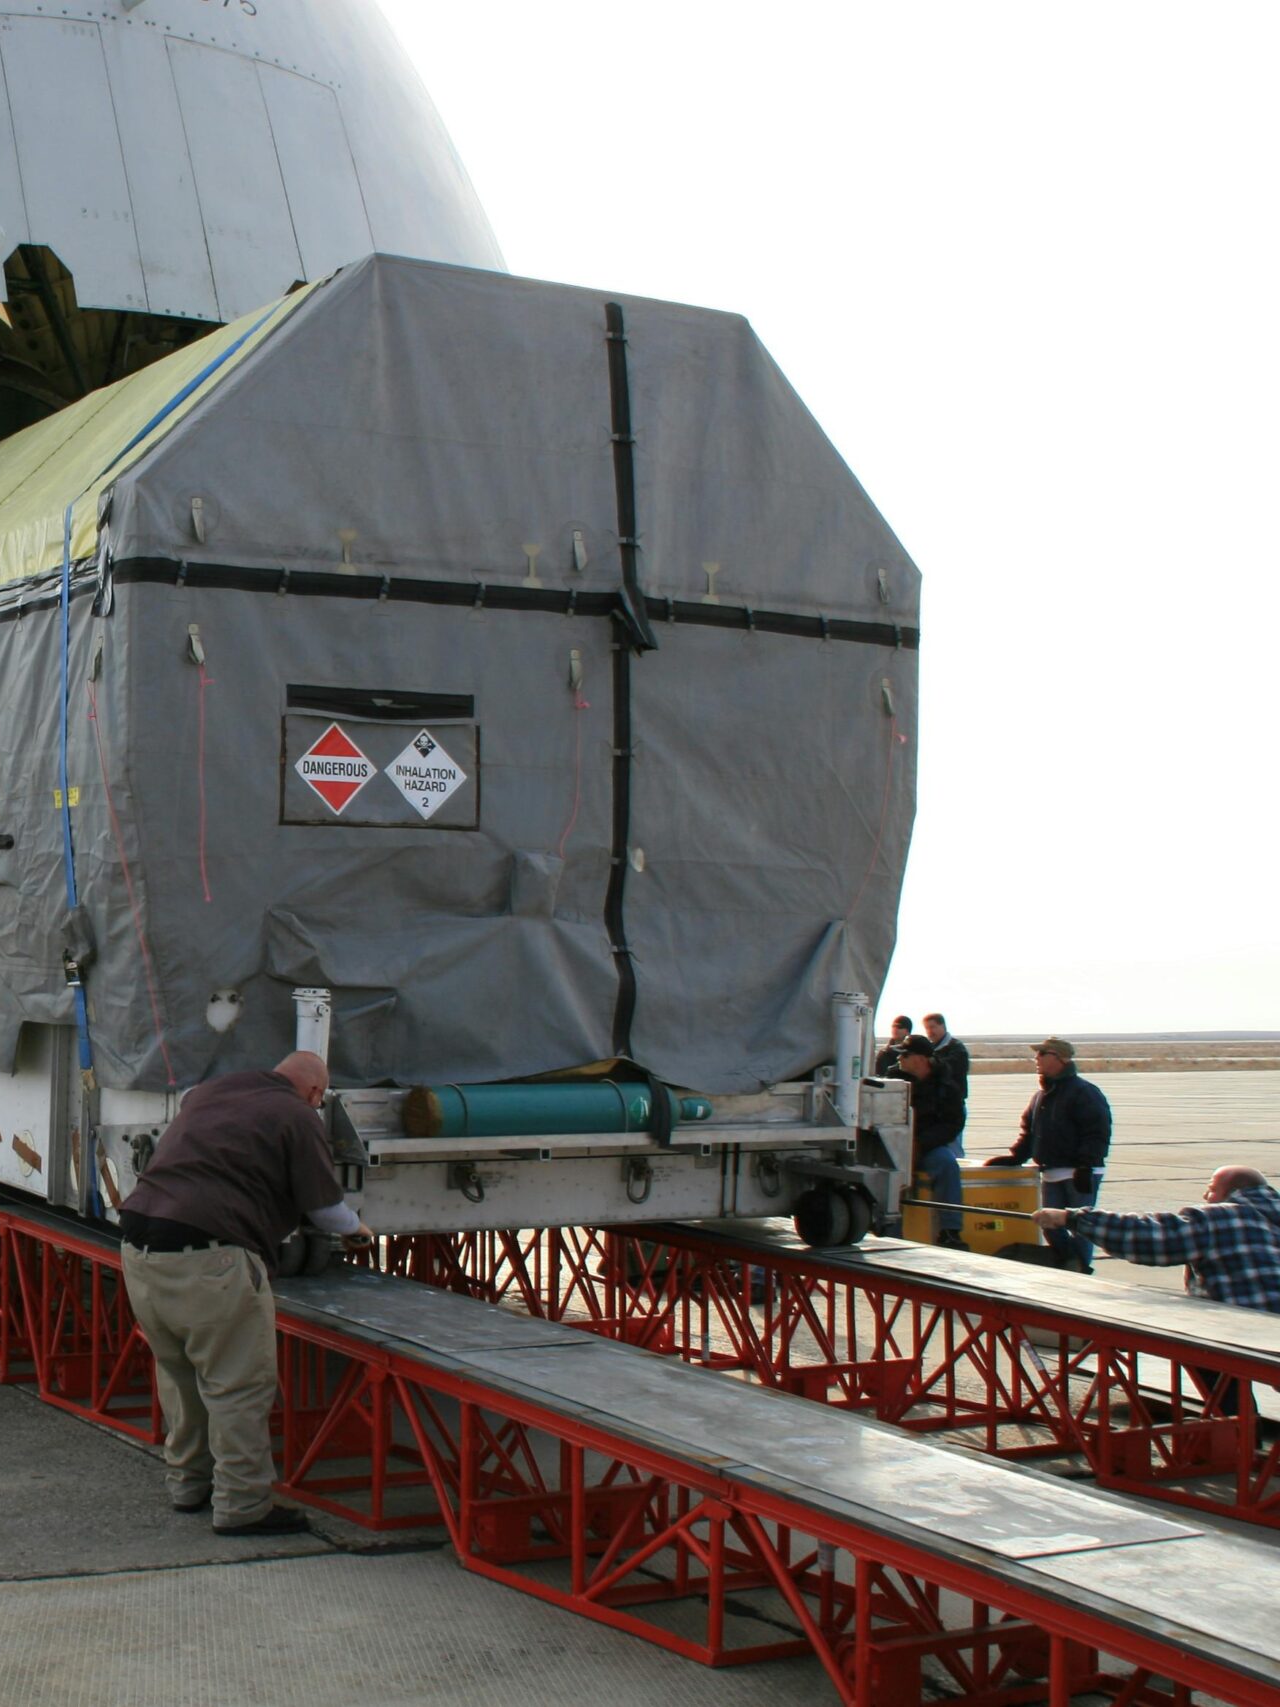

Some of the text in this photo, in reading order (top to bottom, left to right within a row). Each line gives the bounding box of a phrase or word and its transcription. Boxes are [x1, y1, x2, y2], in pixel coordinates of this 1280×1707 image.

[303, 761, 368, 778] DANGEROUS
[395, 764, 456, 780] INHALATION
[404, 780, 447, 793] HAZARD
[422, 797, 429, 808] 2
